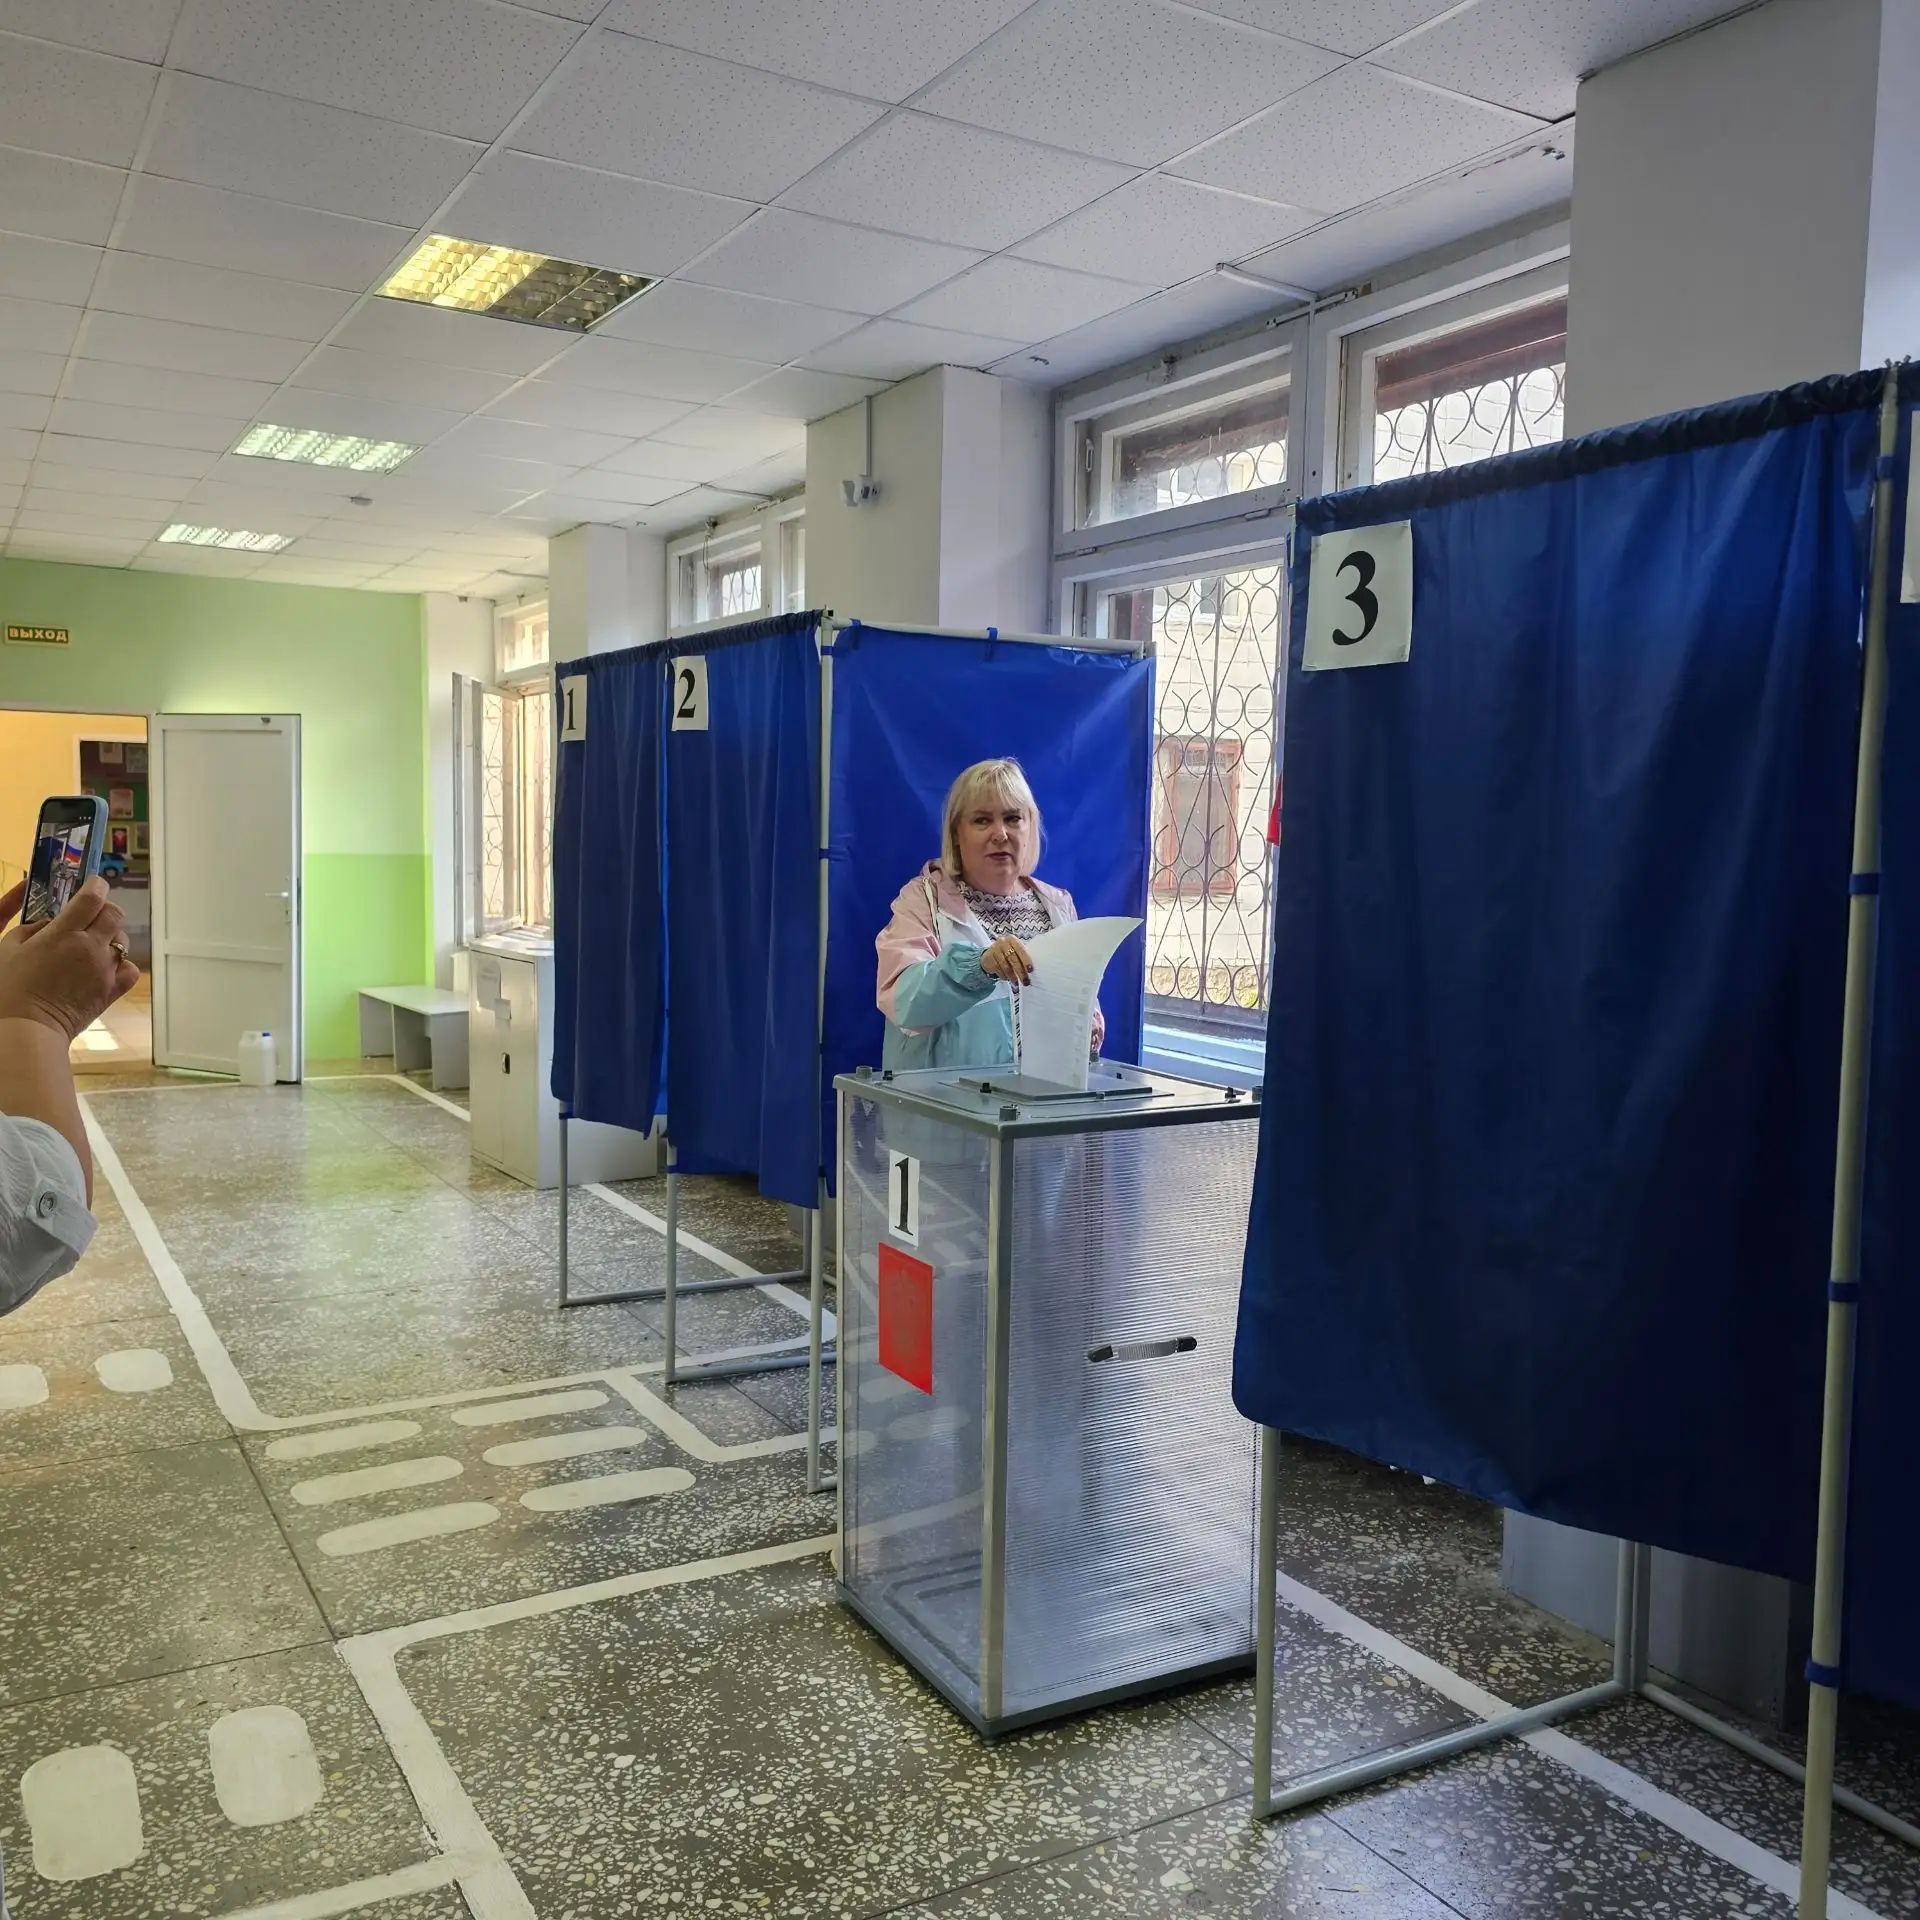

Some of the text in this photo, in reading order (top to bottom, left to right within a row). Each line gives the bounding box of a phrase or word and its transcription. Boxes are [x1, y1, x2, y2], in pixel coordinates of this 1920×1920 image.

[1332, 550, 1379, 646] 3
[9, 627, 67, 642] ВЫХОД
[566, 687, 577, 731] 1
[676, 668, 697, 719] 2
[894, 1156, 914, 1237] 1
